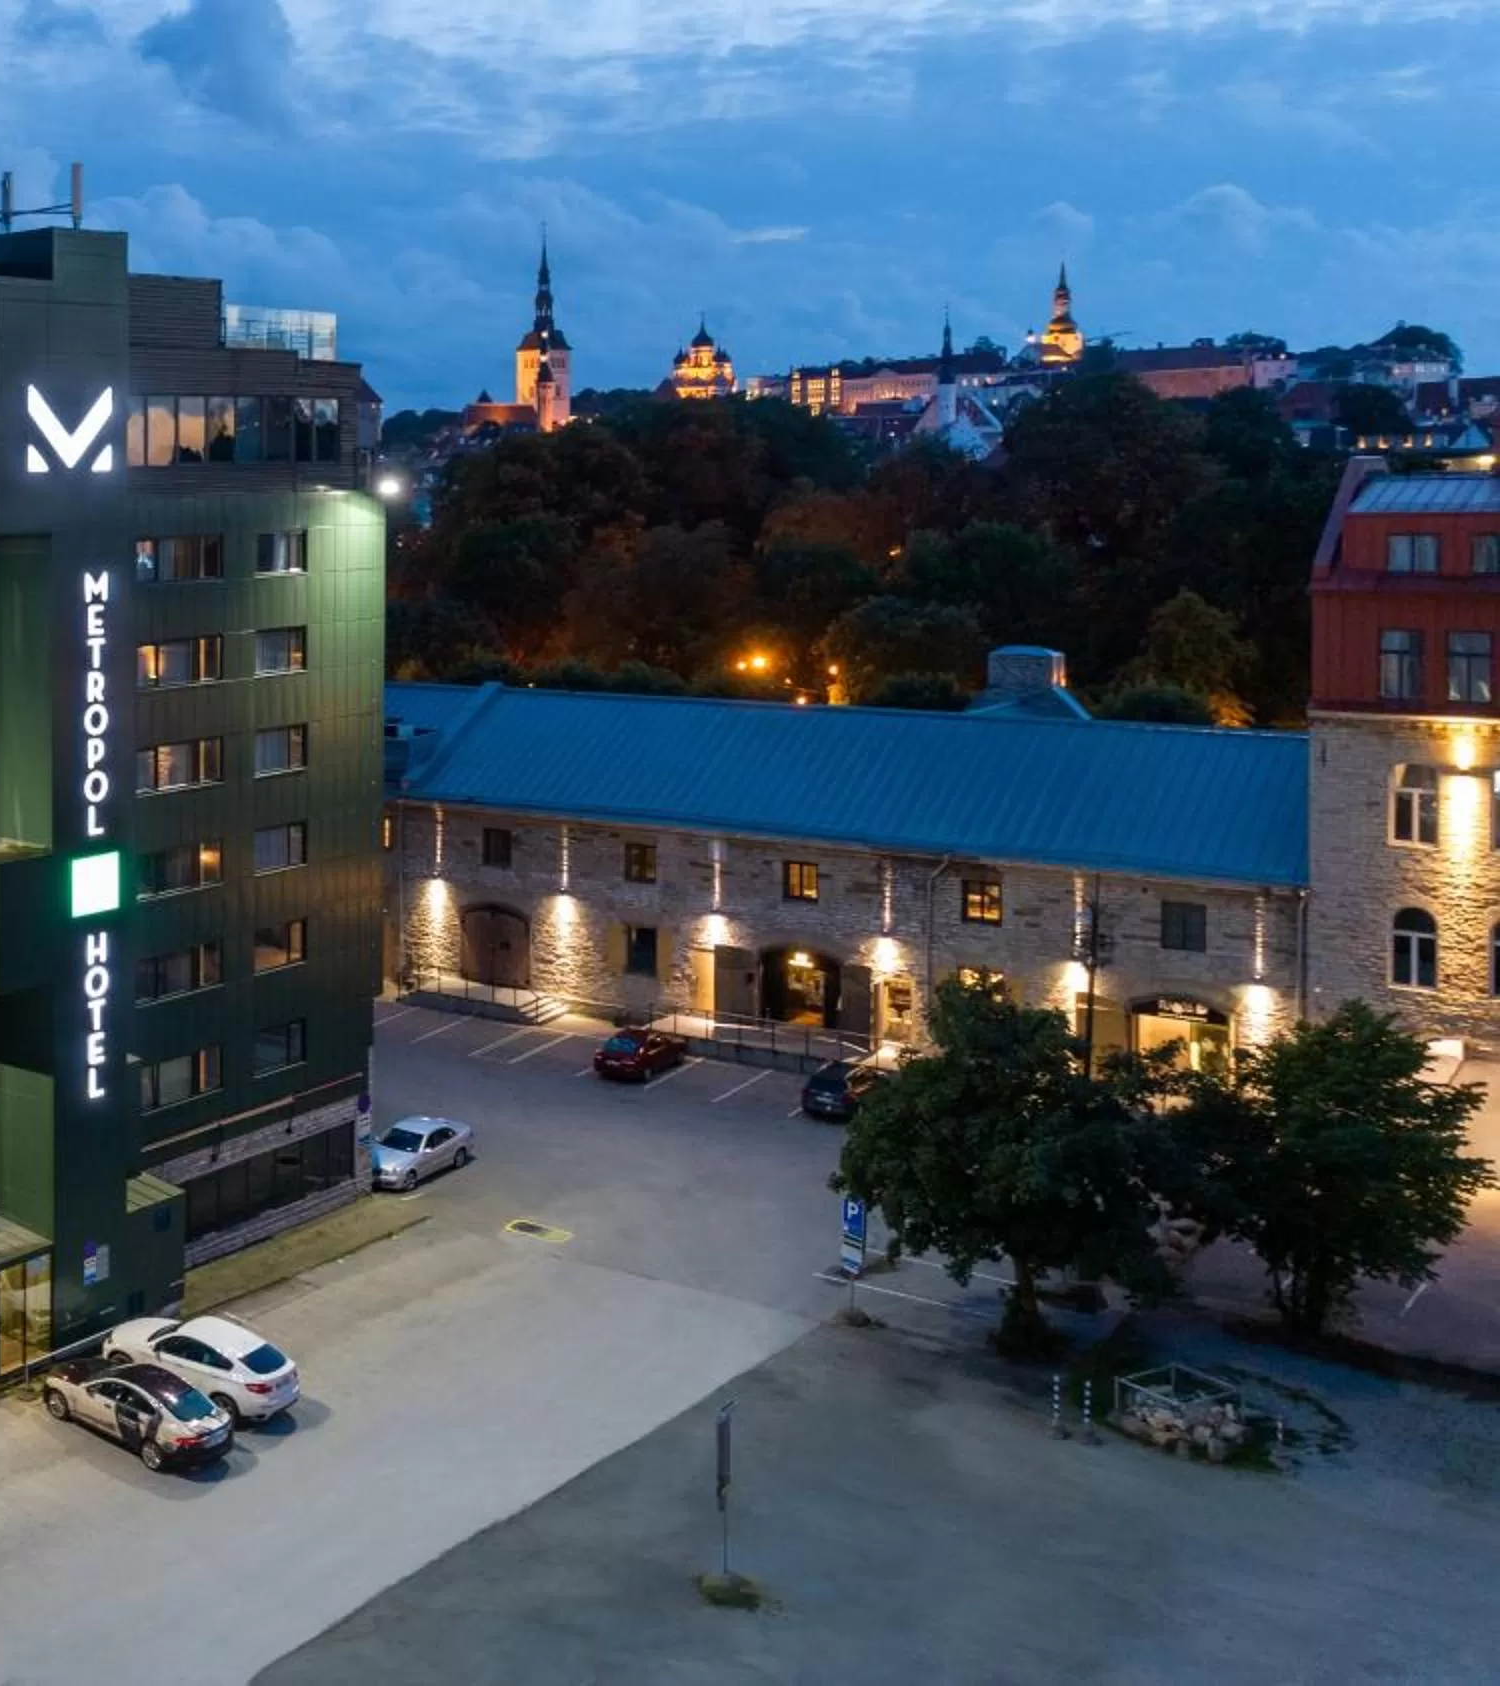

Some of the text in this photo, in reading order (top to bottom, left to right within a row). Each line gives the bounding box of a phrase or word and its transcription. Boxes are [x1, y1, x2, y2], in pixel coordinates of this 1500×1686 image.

[83, 570, 110, 1099] METROPOL HOTEL
[847, 1201, 860, 1220] P
